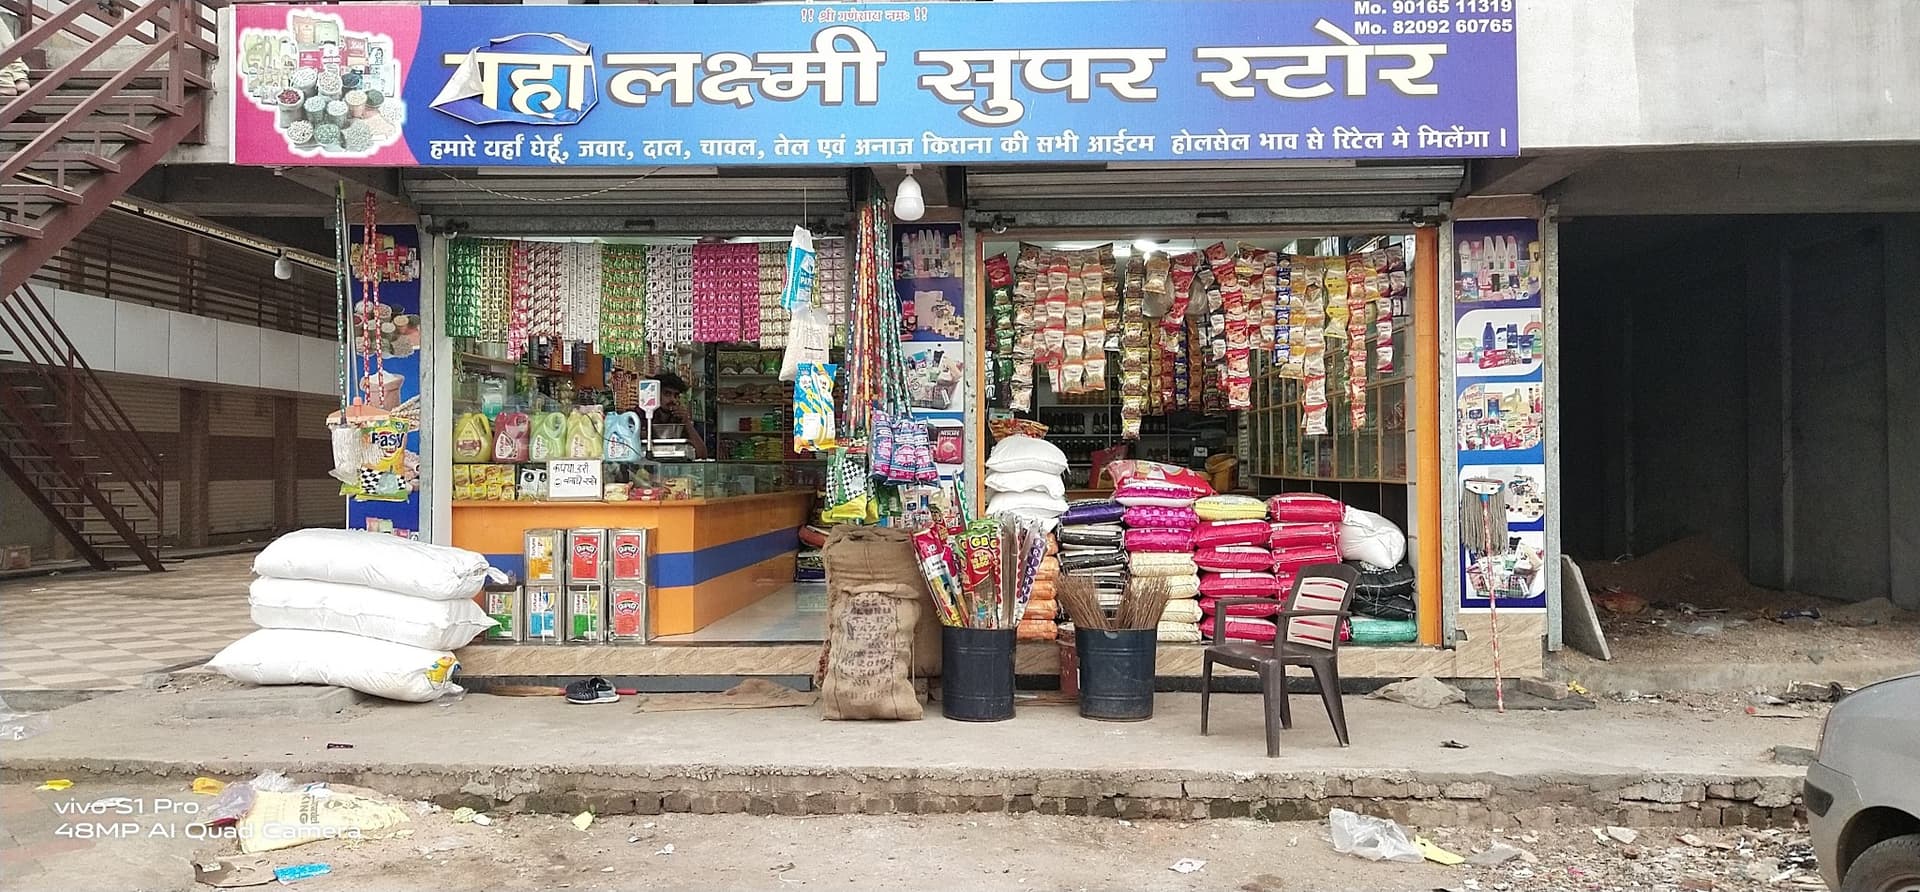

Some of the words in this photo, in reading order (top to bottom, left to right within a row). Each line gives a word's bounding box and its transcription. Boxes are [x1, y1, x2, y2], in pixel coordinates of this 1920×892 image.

[818, 7, 835, 22] श्री
[1354, 0, 1387, 14] Mo.
[1392, 0, 1450, 13] 90165
[1455, 0, 1512, 12] 11319
[1354, 21, 1387, 34] Mo.
[1392, 20, 1450, 33] 82092
[1455, 19, 1512, 32] 60765
[603, 25, 887, 107] लक्ष्मी
[914, 47, 1168, 127] सुपर
[1194, 17, 1448, 99] स्टोर
[429, 135, 476, 160] हमारे
[578, 141, 633, 160] जवार,
[643, 139, 691, 160] दाल,
[700, 138, 765, 160] चावल,
[774, 133, 810, 156] तेल
[817, 134, 846, 159] एवं
[854, 138, 914, 156] अनाज
[922, 131, 992, 155] किराना
[1000, 129, 1029, 154] की
[1036, 128, 1079, 153] सभी
[1087, 129, 1155, 155] आईटम
[1171, 128, 1249, 154] होलसेल
[1259, 132, 1299, 150] भाव
[1306, 126, 1324, 150] से
[1333, 126, 1384, 149] रिटेल
[1392, 126, 1409, 149] मे
[1418, 124, 1489, 148] मिलेंगा
